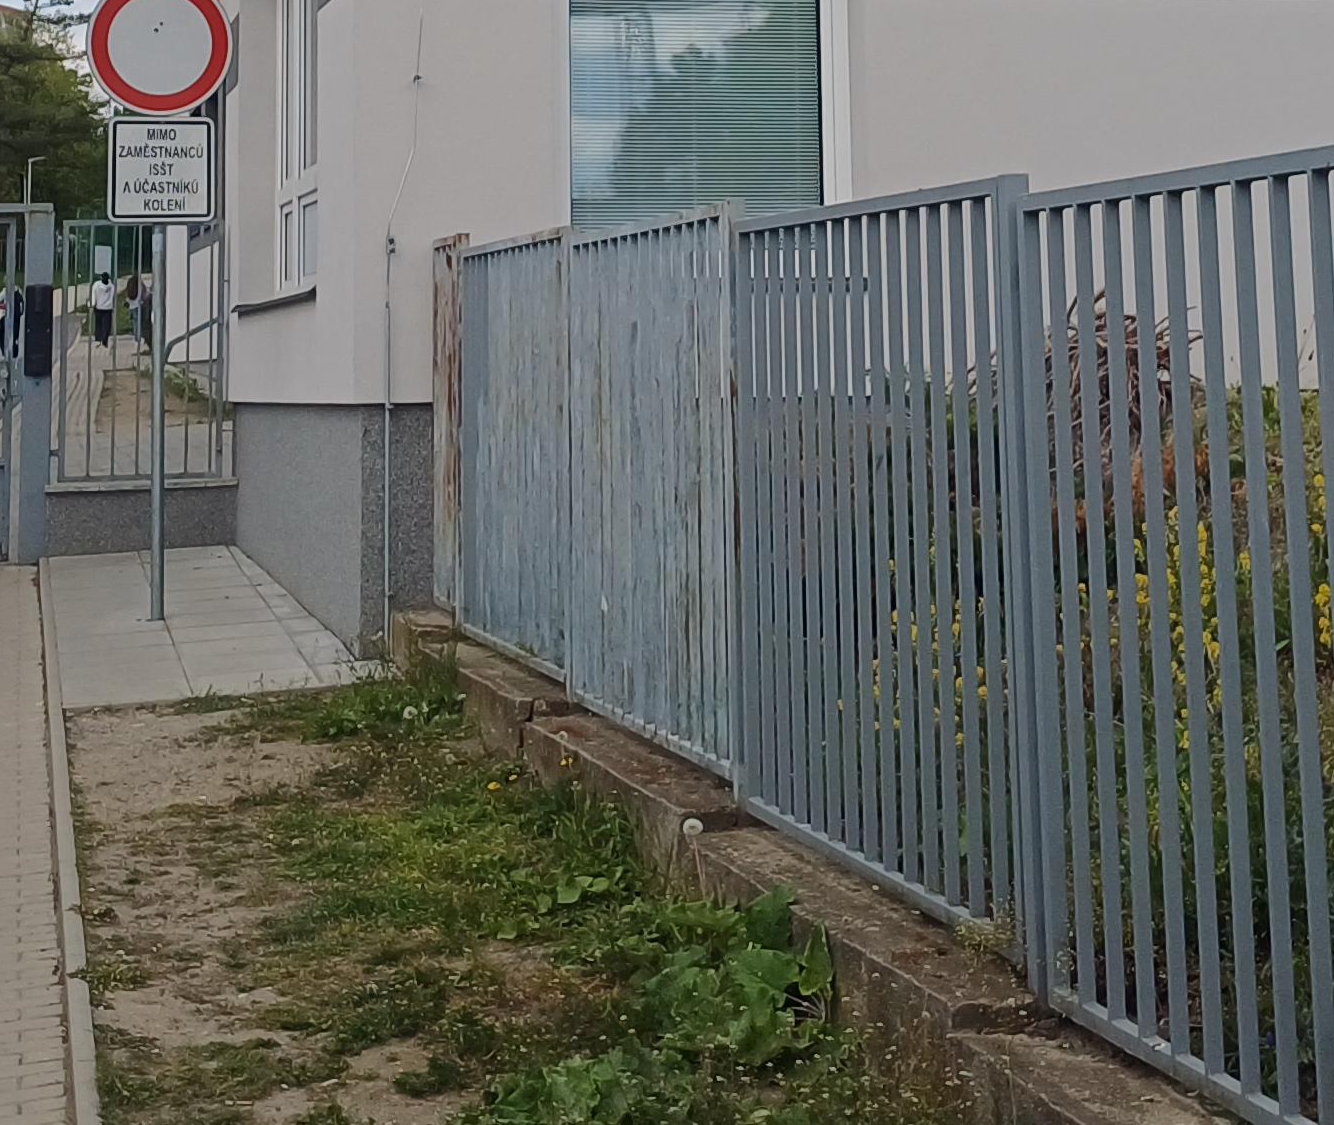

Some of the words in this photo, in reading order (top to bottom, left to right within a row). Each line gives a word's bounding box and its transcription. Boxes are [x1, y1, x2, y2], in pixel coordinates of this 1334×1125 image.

[147, 128, 177, 141] MIMO
[118, 143, 204, 159] ZAMĚSTNANCŮ
[149, 161, 174, 176] ISŠT
